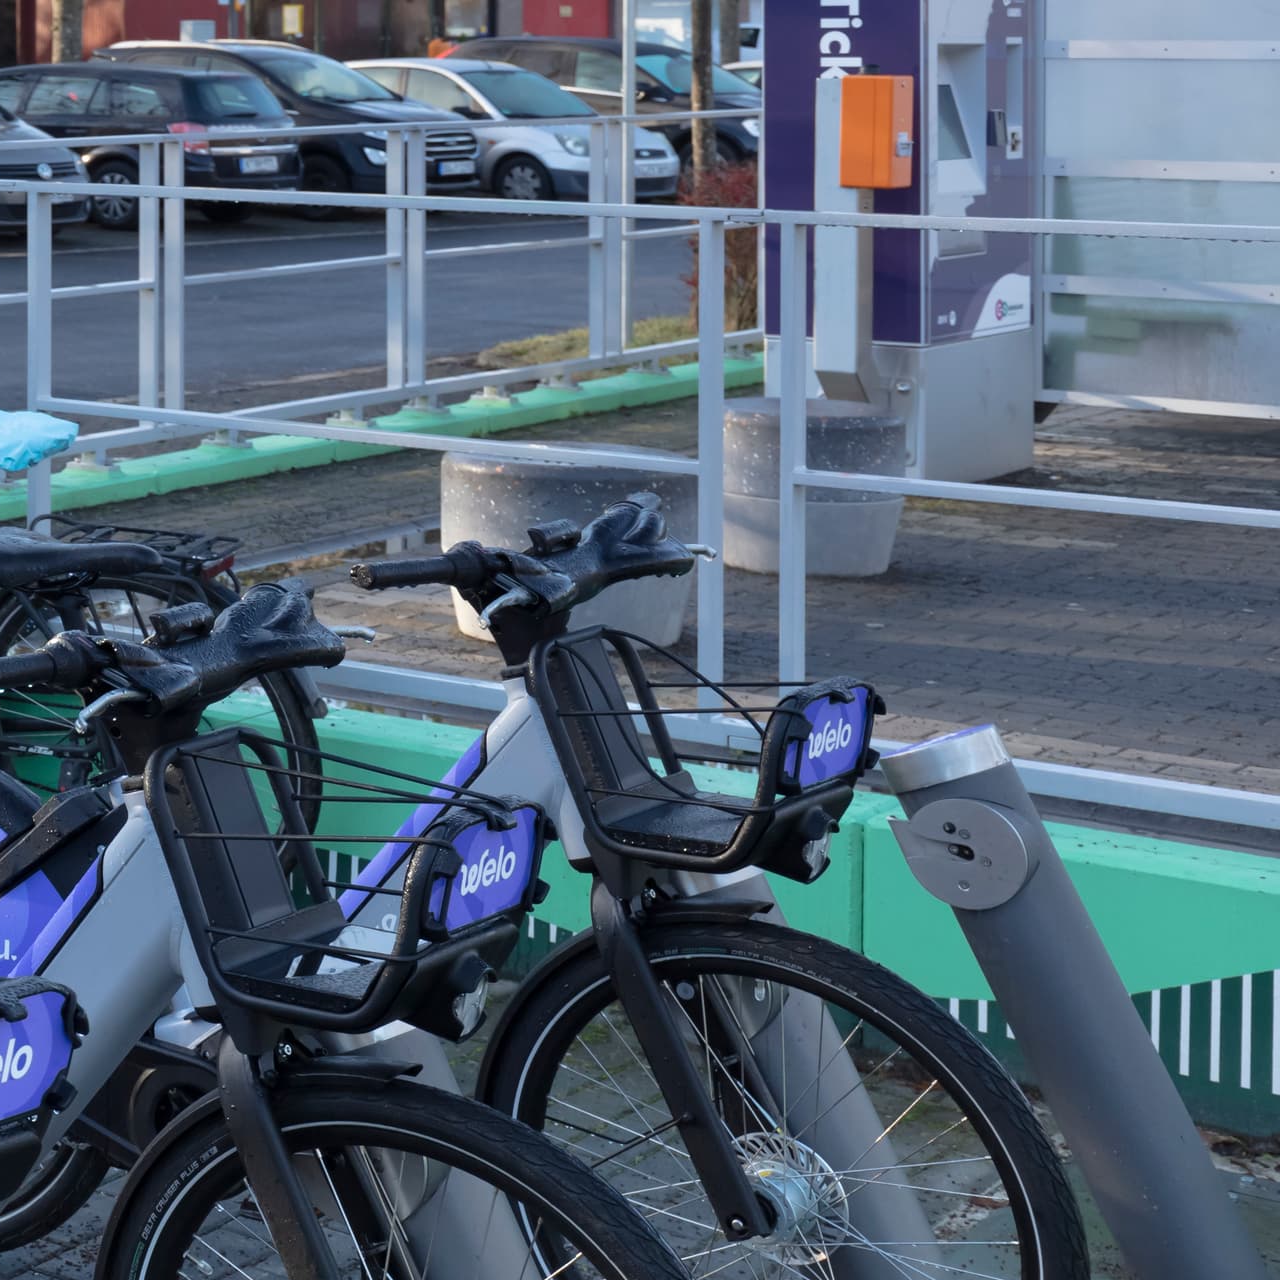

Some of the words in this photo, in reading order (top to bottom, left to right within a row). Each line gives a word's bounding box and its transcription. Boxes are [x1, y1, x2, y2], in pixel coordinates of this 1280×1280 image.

[808, 718, 852, 760] Welo
[460, 844, 517, 897] Welo
[142, 1211, 157, 1241] DELTA
[155, 1179, 181, 1214] CRUISER
[180, 1160, 200, 1181] PLUS
